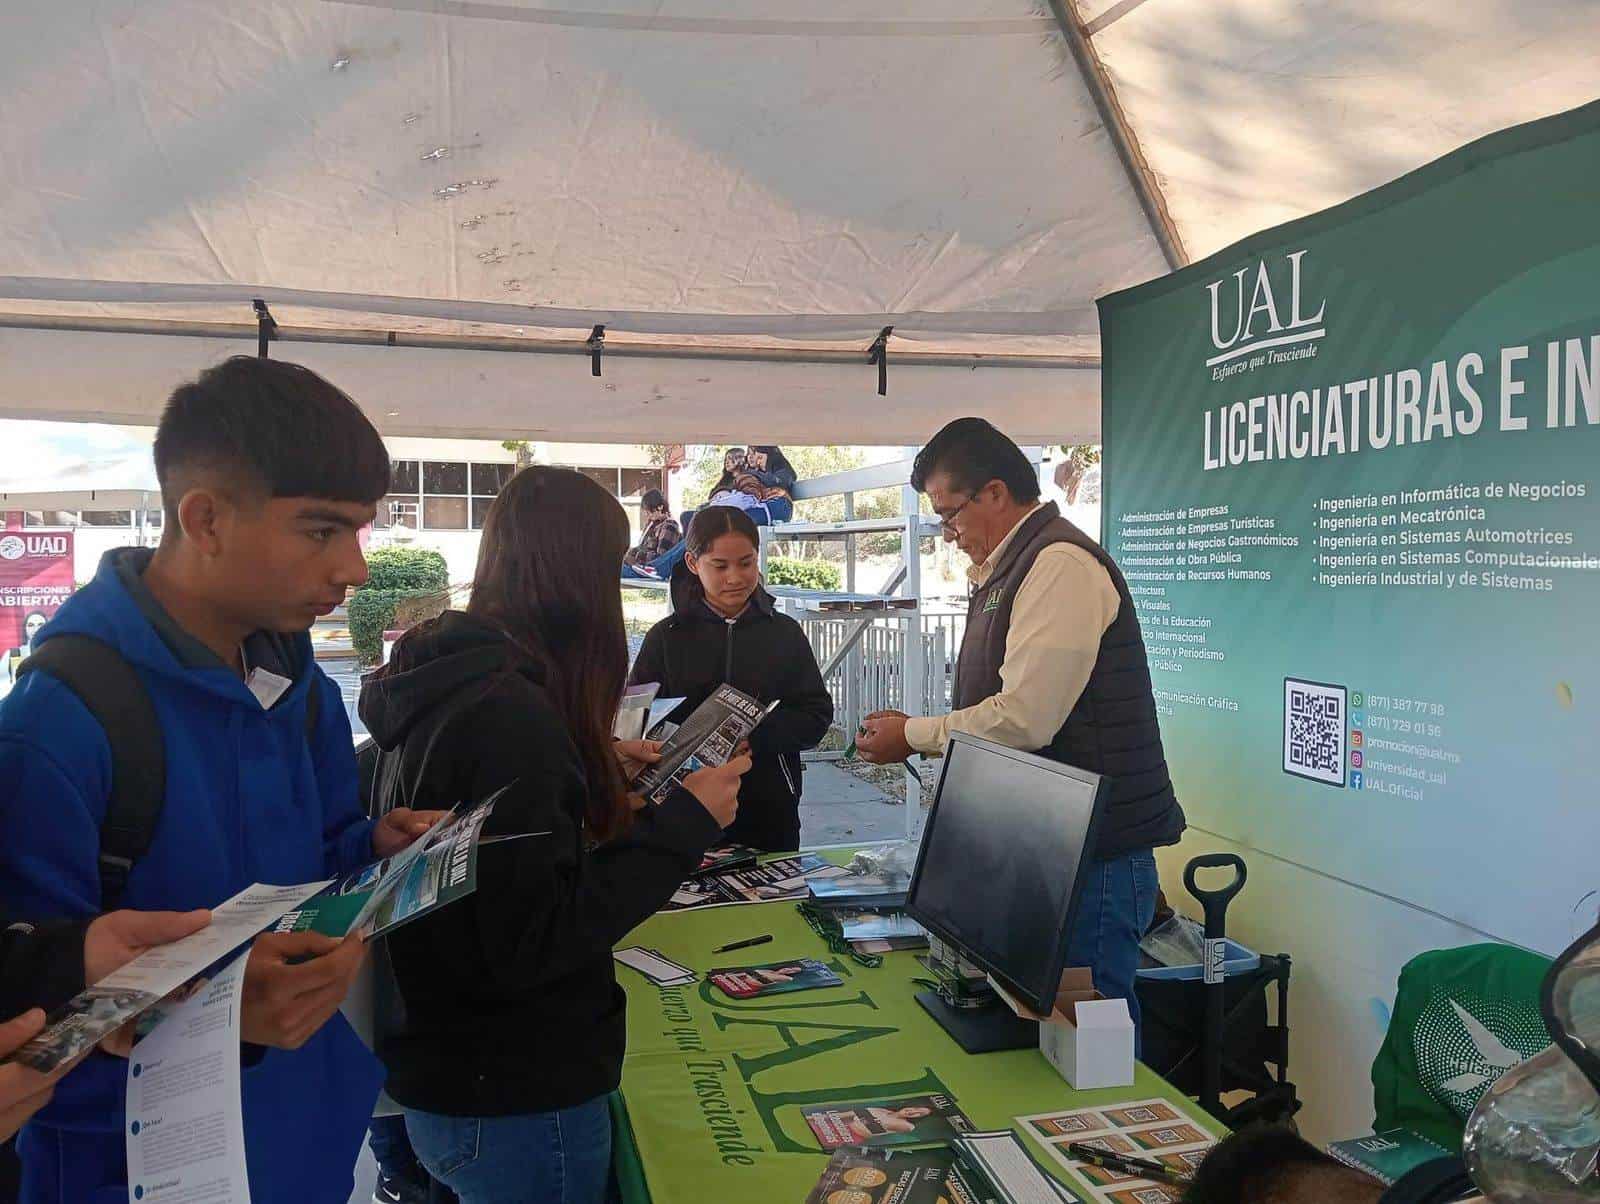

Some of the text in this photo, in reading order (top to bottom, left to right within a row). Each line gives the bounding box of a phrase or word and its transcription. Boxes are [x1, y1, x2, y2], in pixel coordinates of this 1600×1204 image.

[1205, 249, 1326, 350] UAL
[1212, 343, 1318, 381] Esfuerzo que Trasciende
[1203, 335, 1600, 470] LICENCIATURAS E IN
[1320, 481, 1585, 511] Ingeniería en Informática de Negocios
[1122, 505, 1229, 522] Administración de Empresas
[1320, 506, 1485, 530] Ingeniería en Mecatrónica
[1122, 516, 1275, 537] Administración de Empresas Turísticas
[26, 536, 68, 554] UAD
[1122, 533, 1299, 551] Administración de Negocios Gastronómicos
[1320, 527, 1573, 550] Ingeniería en Sistemas Automotrices
[1122, 552, 1242, 566] Administración de Obra Pública
[1319, 549, 1600, 568] Ingeniería en Sistemas Computacionale
[1176, 570, 1186, 580] de
[1188, 569, 1226, 581] Recursos
[1228, 568, 1271, 580] Humanos
[1319, 571, 1553, 591] Ingeniería Industrial y de Sistemas
[1129, 583, 1165, 596] quitectura
[1141, 600, 1170, 611] Visuales
[1152, 615, 1161, 625] de
[1162, 615, 1169, 625] la
[1171, 615, 1211, 628] Educación
[1155, 631, 1206, 643] Internacional
[1172, 648, 1178, 659] y
[1179, 646, 1224, 661] Periodismo
[1154, 659, 1183, 672] Público
[1208, 696, 1239, 711] Gráfica
[1367, 695, 1390, 711] (871)
[1414, 700, 1428, 713] 77
[1367, 714, 1390, 731] (871)
[1392, 718, 1412, 732] 729
[1367, 759, 1448, 785] universidad_ual
[1212, 941, 1225, 983] UAL
[699, 957, 958, 1157] UAL
[659, 986, 765, 1166] uerzo que Trasciende
